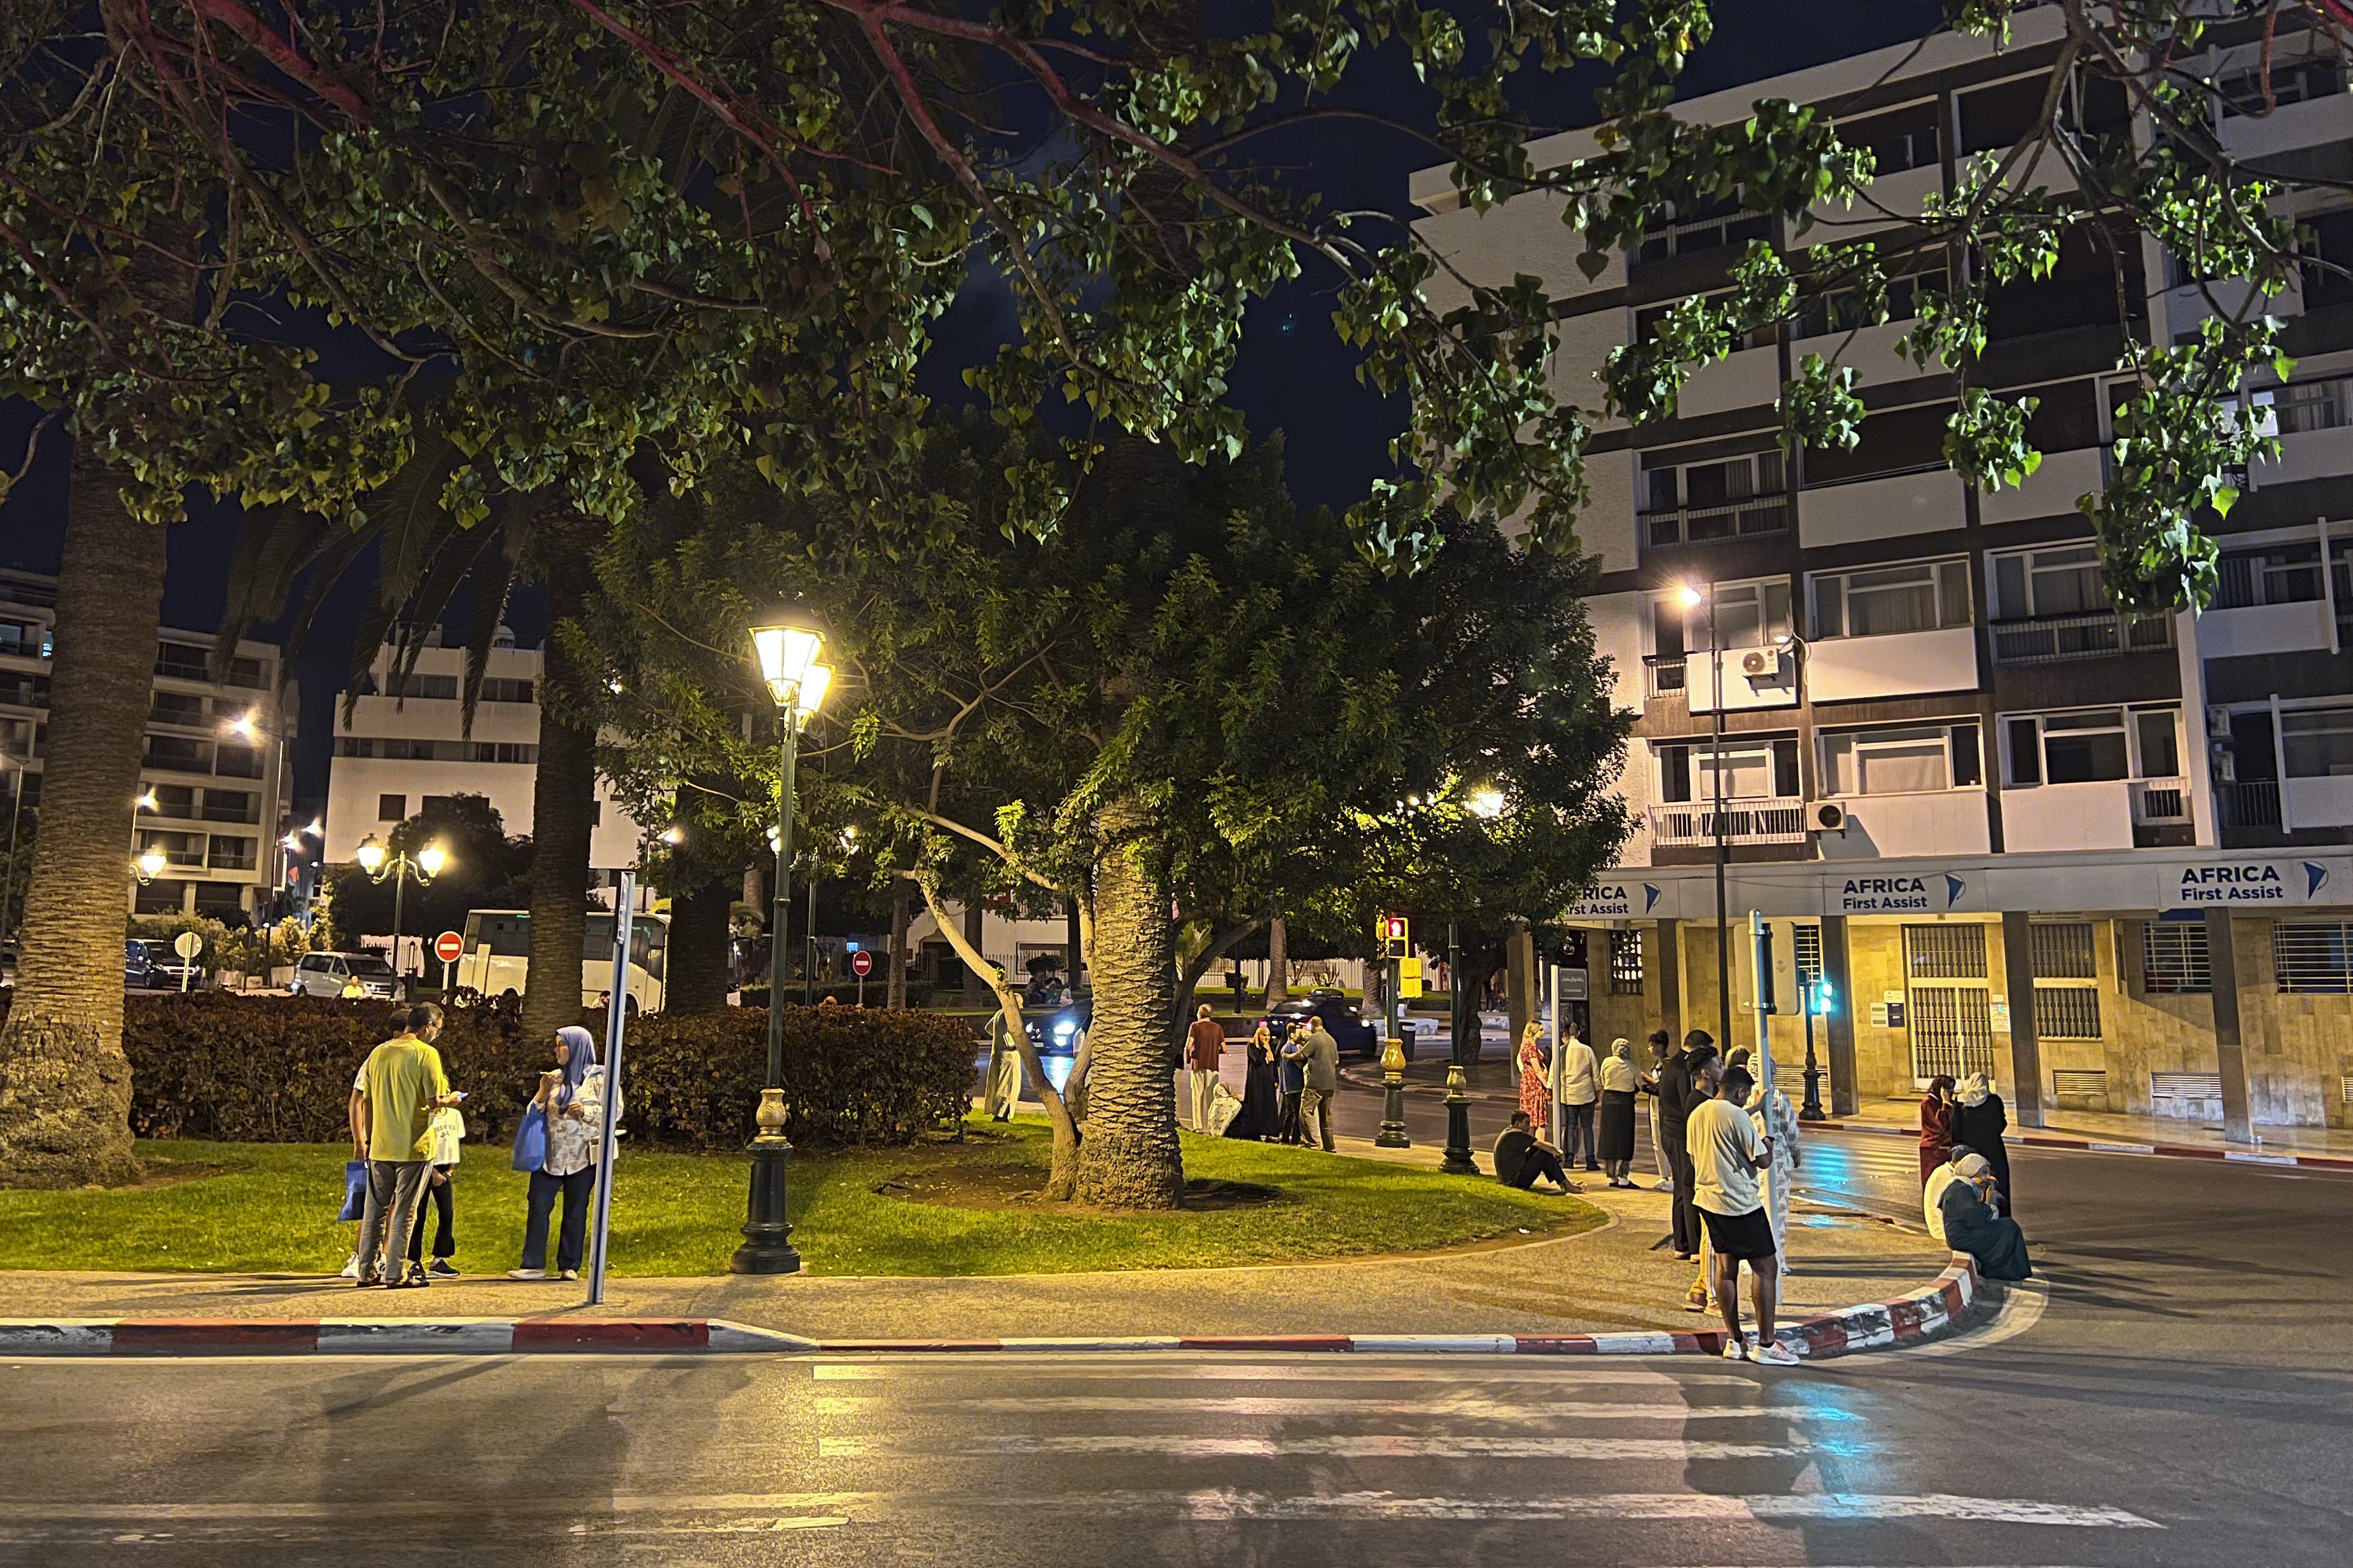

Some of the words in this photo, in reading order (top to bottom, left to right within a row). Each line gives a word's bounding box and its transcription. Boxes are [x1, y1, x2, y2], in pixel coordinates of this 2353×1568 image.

[2181, 865, 2280, 884] AFRICA
[1581, 885, 1627, 900] RICA
[1843, 877, 1926, 894] AFRICA
[2181, 887, 2223, 901] First
[2228, 885, 2284, 899] Assist
[1589, 903, 1629, 915] Assist
[1843, 898, 1878, 910] First
[1881, 896, 1928, 908] Assist
